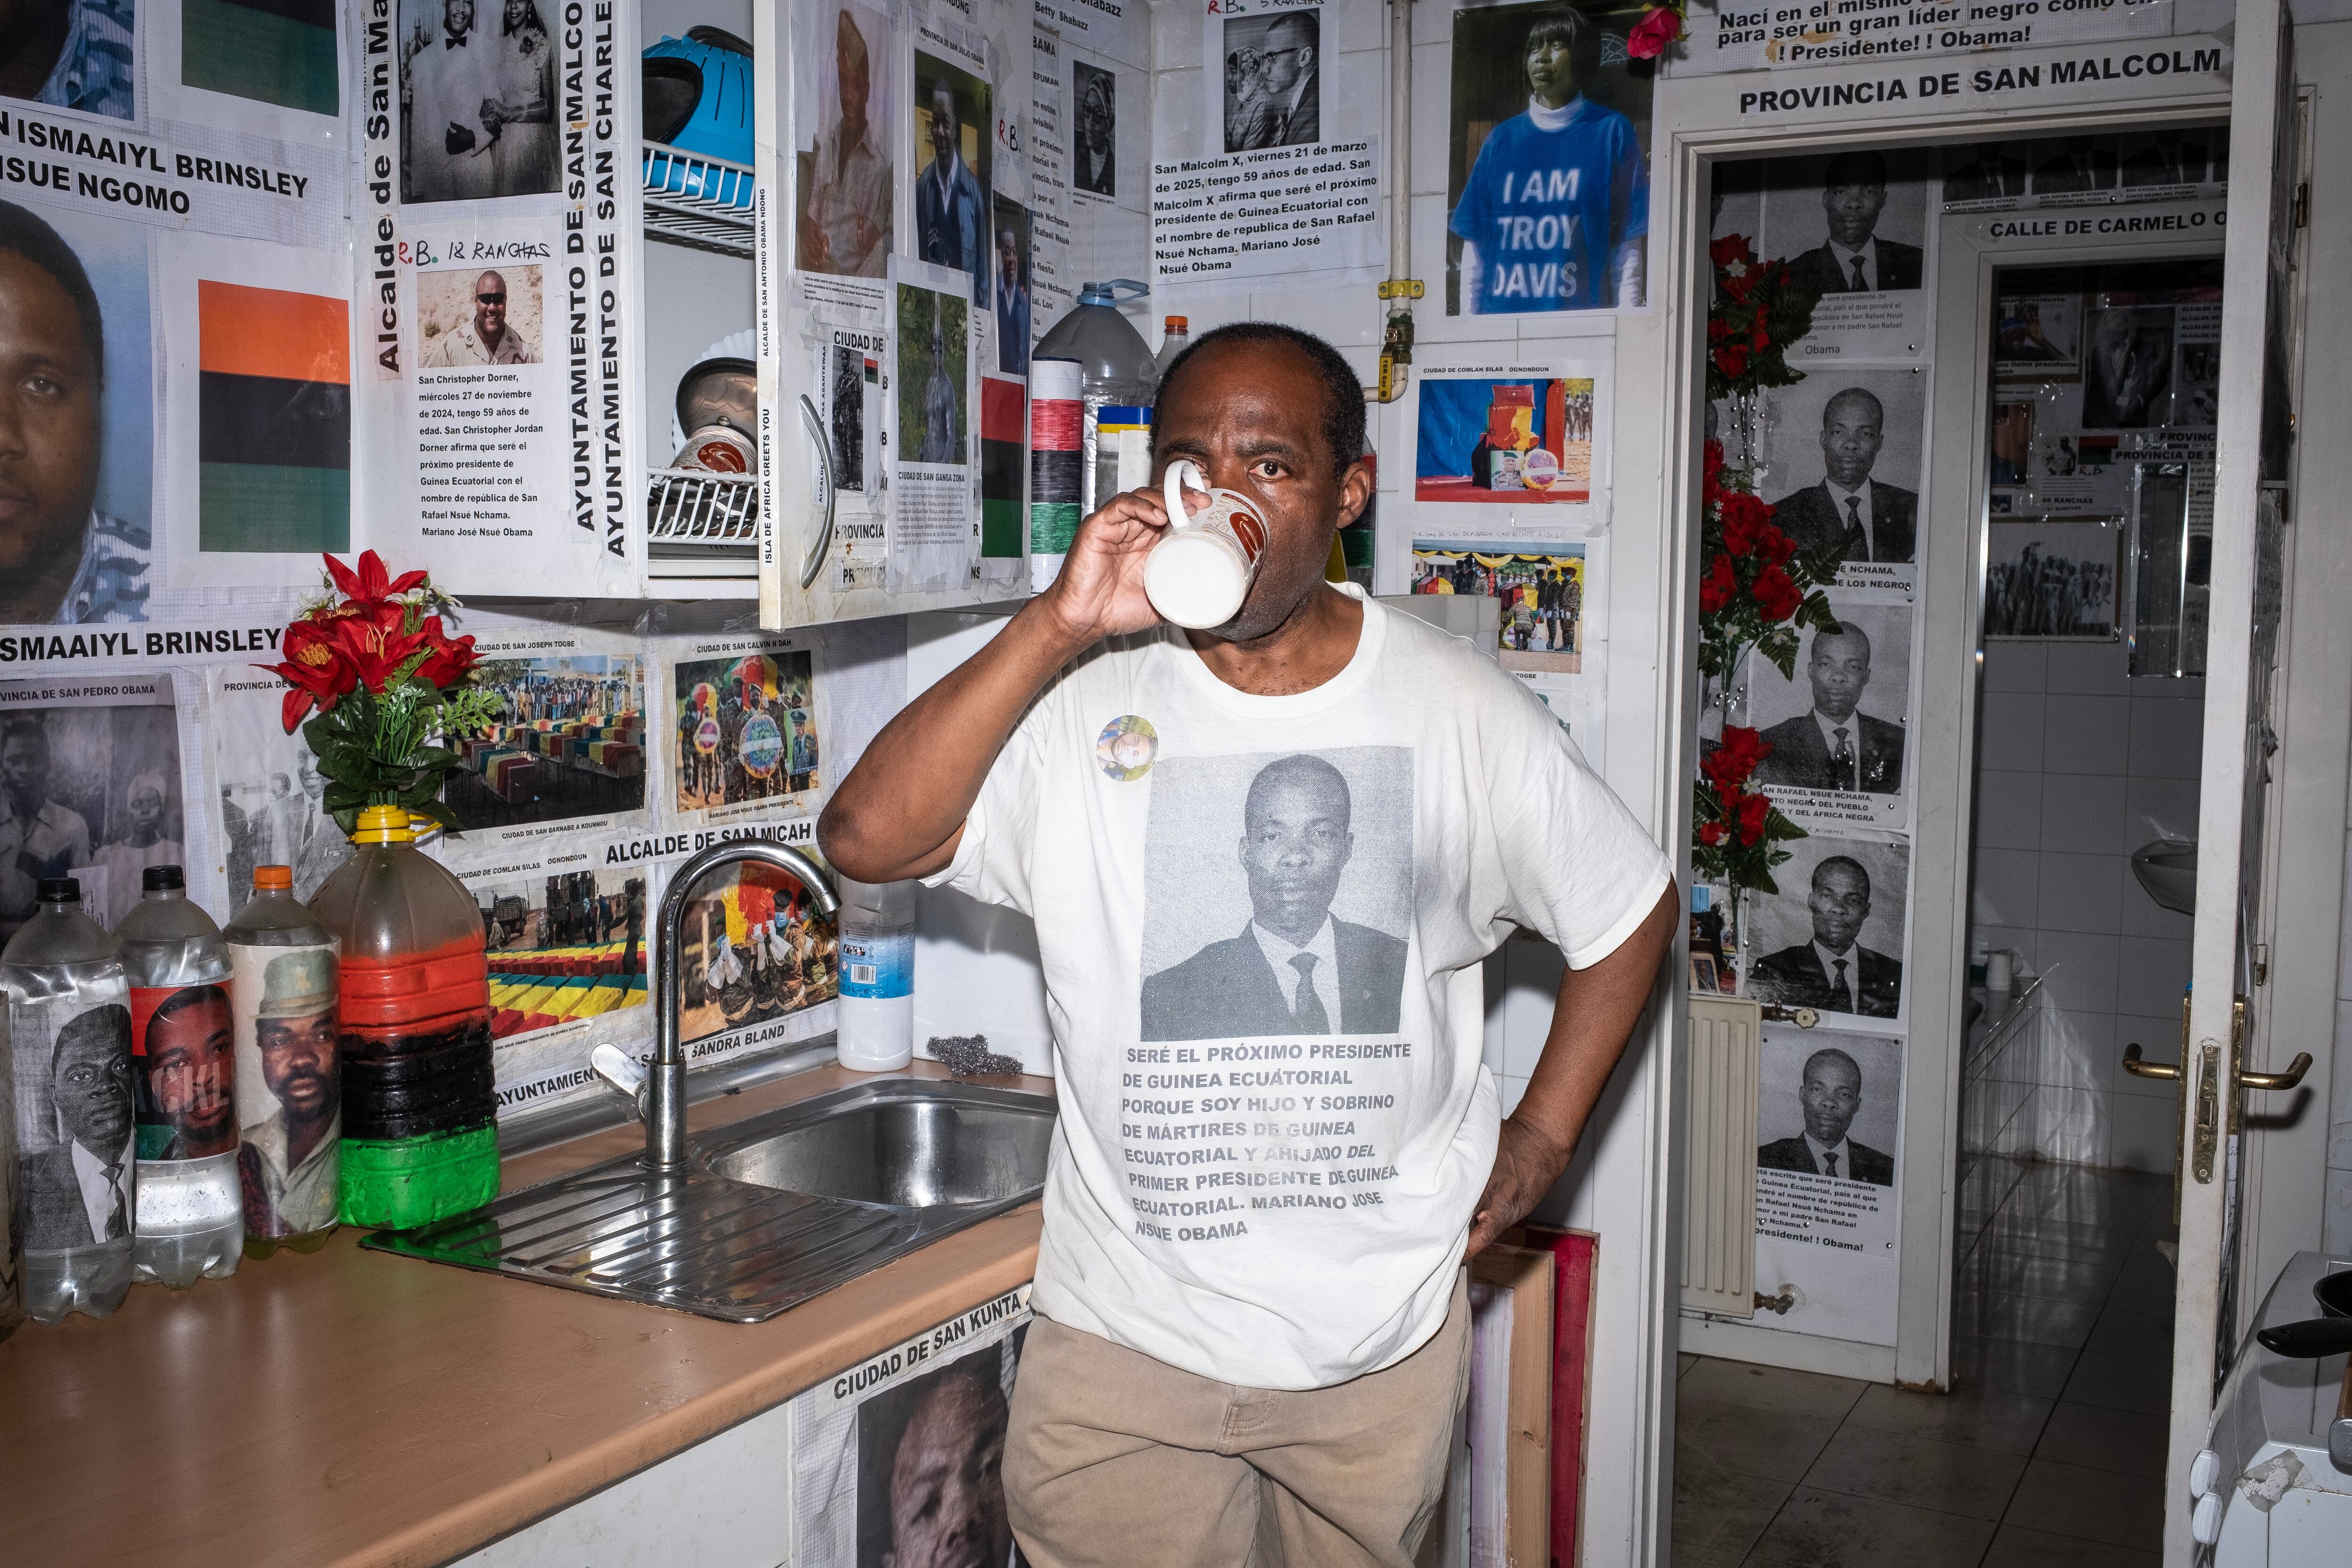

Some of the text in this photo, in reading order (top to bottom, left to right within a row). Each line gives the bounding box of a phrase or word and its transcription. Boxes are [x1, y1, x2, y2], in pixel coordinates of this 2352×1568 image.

[1034, 2, 1088, 31] Betty Shabazz
[1717, 1, 2040, 49] para ser un gran líder negro
[1740, 48, 2220, 113] PROVINCIA DE SAN MALCOLM
[17, 119, 166, 173] ISMAAIYL
[175, 154, 308, 198] BRINSLEY
[565, 130, 585, 199] SAN
[1155, 143, 1367, 174] San Malcolm X, viernes 21 de marzo
[596, 151, 615, 220] SAN
[1155, 159, 1370, 192] de 2025, tengo 59 años de edad. San
[1503, 168, 1581, 204] I AM
[78, 172, 190, 214] NGOMO
[367, 63, 400, 373] Alcalde de San
[566, 210, 584, 254] DE
[1498, 215, 1581, 250] TROY
[1990, 212, 2206, 237] CALLE DE CARMELO
[598, 233, 615, 277] DE
[1492, 262, 1577, 298] DAVIS
[762, 308, 767, 318] DE
[437, 374, 485, 384] Christopher
[488, 374, 518, 382] Dorner,
[419, 392, 460, 401] miércoles
[475, 391, 485, 399] de
[488, 390, 532, 398] noviembre
[568, 266, 595, 532] AYUNTAMIENTO
[432, 409, 454, 419] 2024,
[457, 409, 480, 419] tengo
[600, 290, 625, 558] AYUNTAMIENTO
[420, 426, 442, 435] edad.
[463, 425, 512, 435] Christopher
[898, 471, 915, 480] CIUDAD
[916, 472, 922, 481] DE
[923, 472, 934, 481] SAN
[936, 473, 952, 482] GANGA
[764, 523, 771, 536] DE
[0, 628, 281, 661] SMAAIYL BRINSLEY
[1834, 792, 1872, 802] NCHAMA,
[606, 834, 689, 864] ALCALDE
[695, 832, 715, 852] DE
[760, 823, 811, 843] MICAH
[691, 1025, 784, 1056] SANDRA BLAND
[1127, 1043, 1411, 1063] SERÉ EL PRÓXIMO PRESIDENTE
[1122, 1073, 1142, 1088] DE
[1147, 1073, 1223, 1089] GUINEA
[1122, 1094, 1394, 1115] PORQUE SOY HIJO Y SOBRINO
[1122, 1121, 1355, 1140] DE MÁRTIRES DE GUINEA
[1124, 1144, 1375, 1166] ECUATORIAL Y AHIJADO DEL
[1128, 1164, 1399, 1191] PRIMER PRESIDENTE DE GUINEA
[1834, 1181, 1876, 1192] presidente
[1131, 1192, 1383, 1216] ECUATORIAL. MARIANO JOSE
[1135, 1220, 1248, 1241] NSUE OBAMA
[834, 1292, 1021, 1399] CIUDAD DE SAN KUNTA
